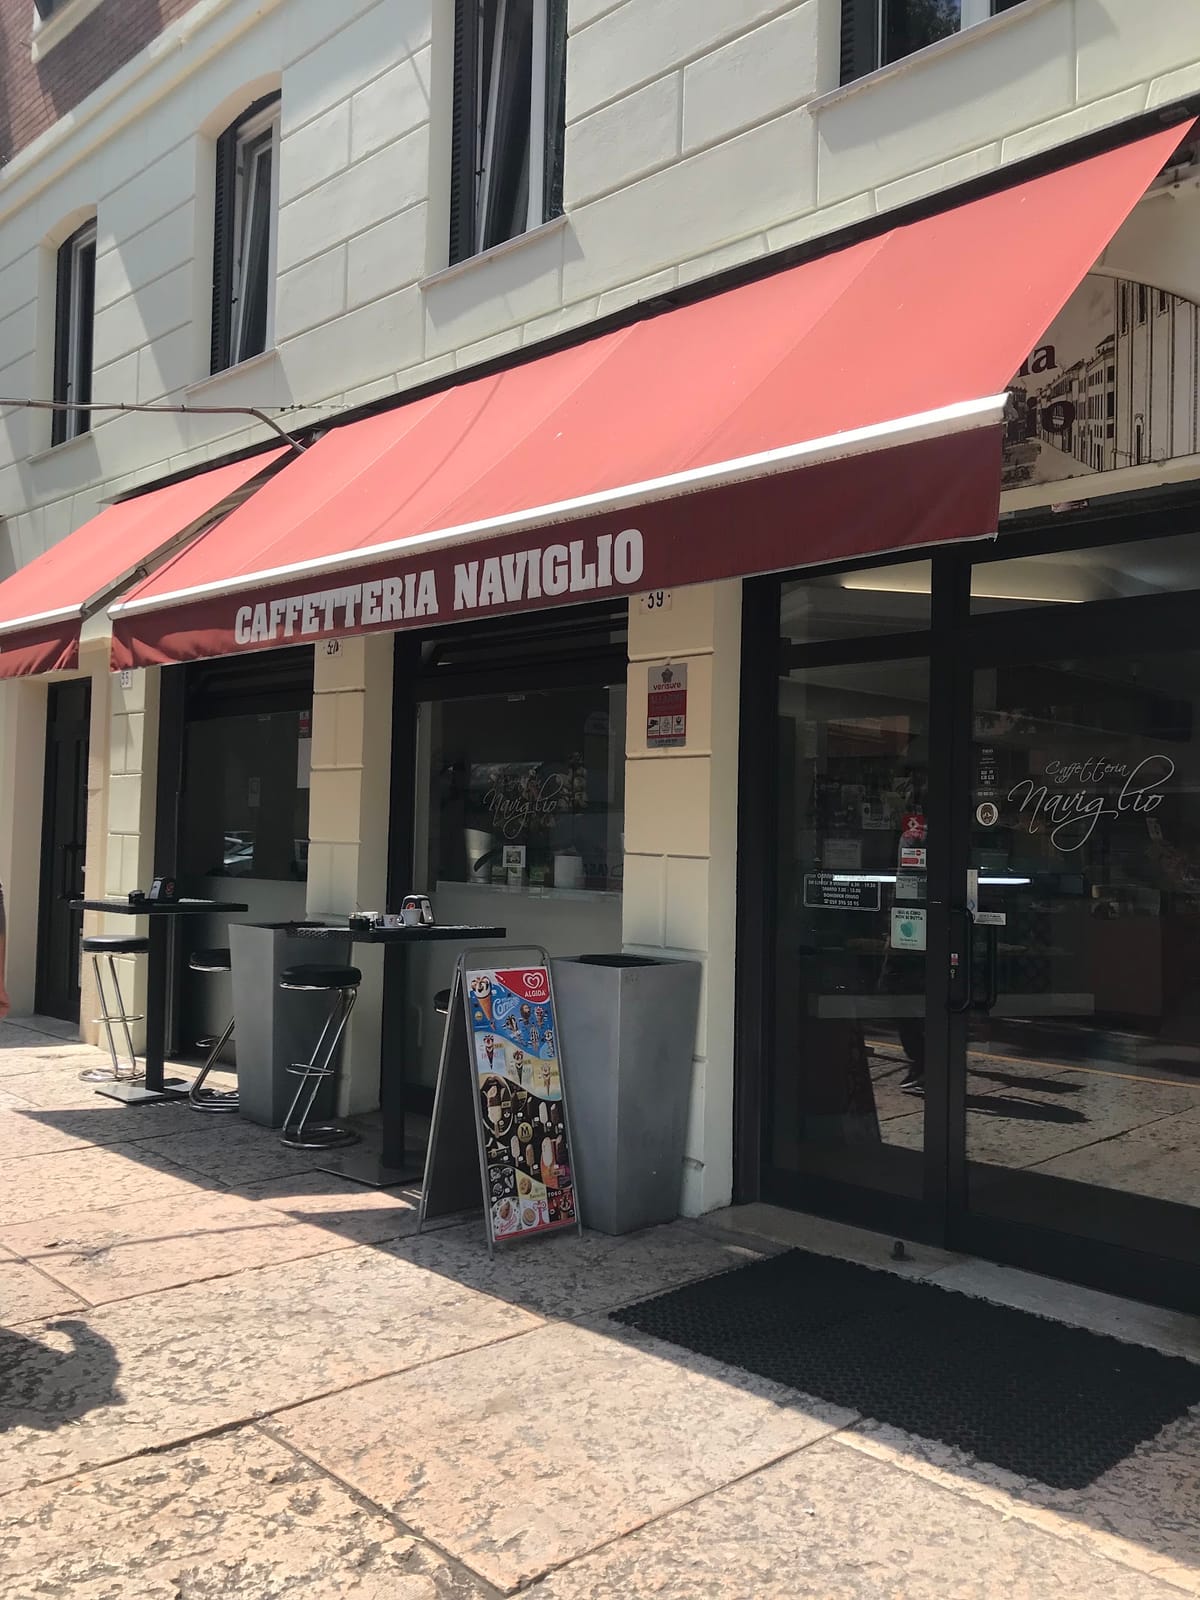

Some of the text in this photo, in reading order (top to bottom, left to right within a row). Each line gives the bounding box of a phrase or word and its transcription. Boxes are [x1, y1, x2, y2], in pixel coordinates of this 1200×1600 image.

[234, 528, 644, 645] CAFFETTERIA NAVIGLIO
[653, 681, 682, 690] verisure
[1045, 756, 1130, 783] Caffetteria
[483, 773, 564, 839] Naviglio
[1007, 755, 1175, 851] Naviglio
[525, 990, 546, 998] ALGIDA
